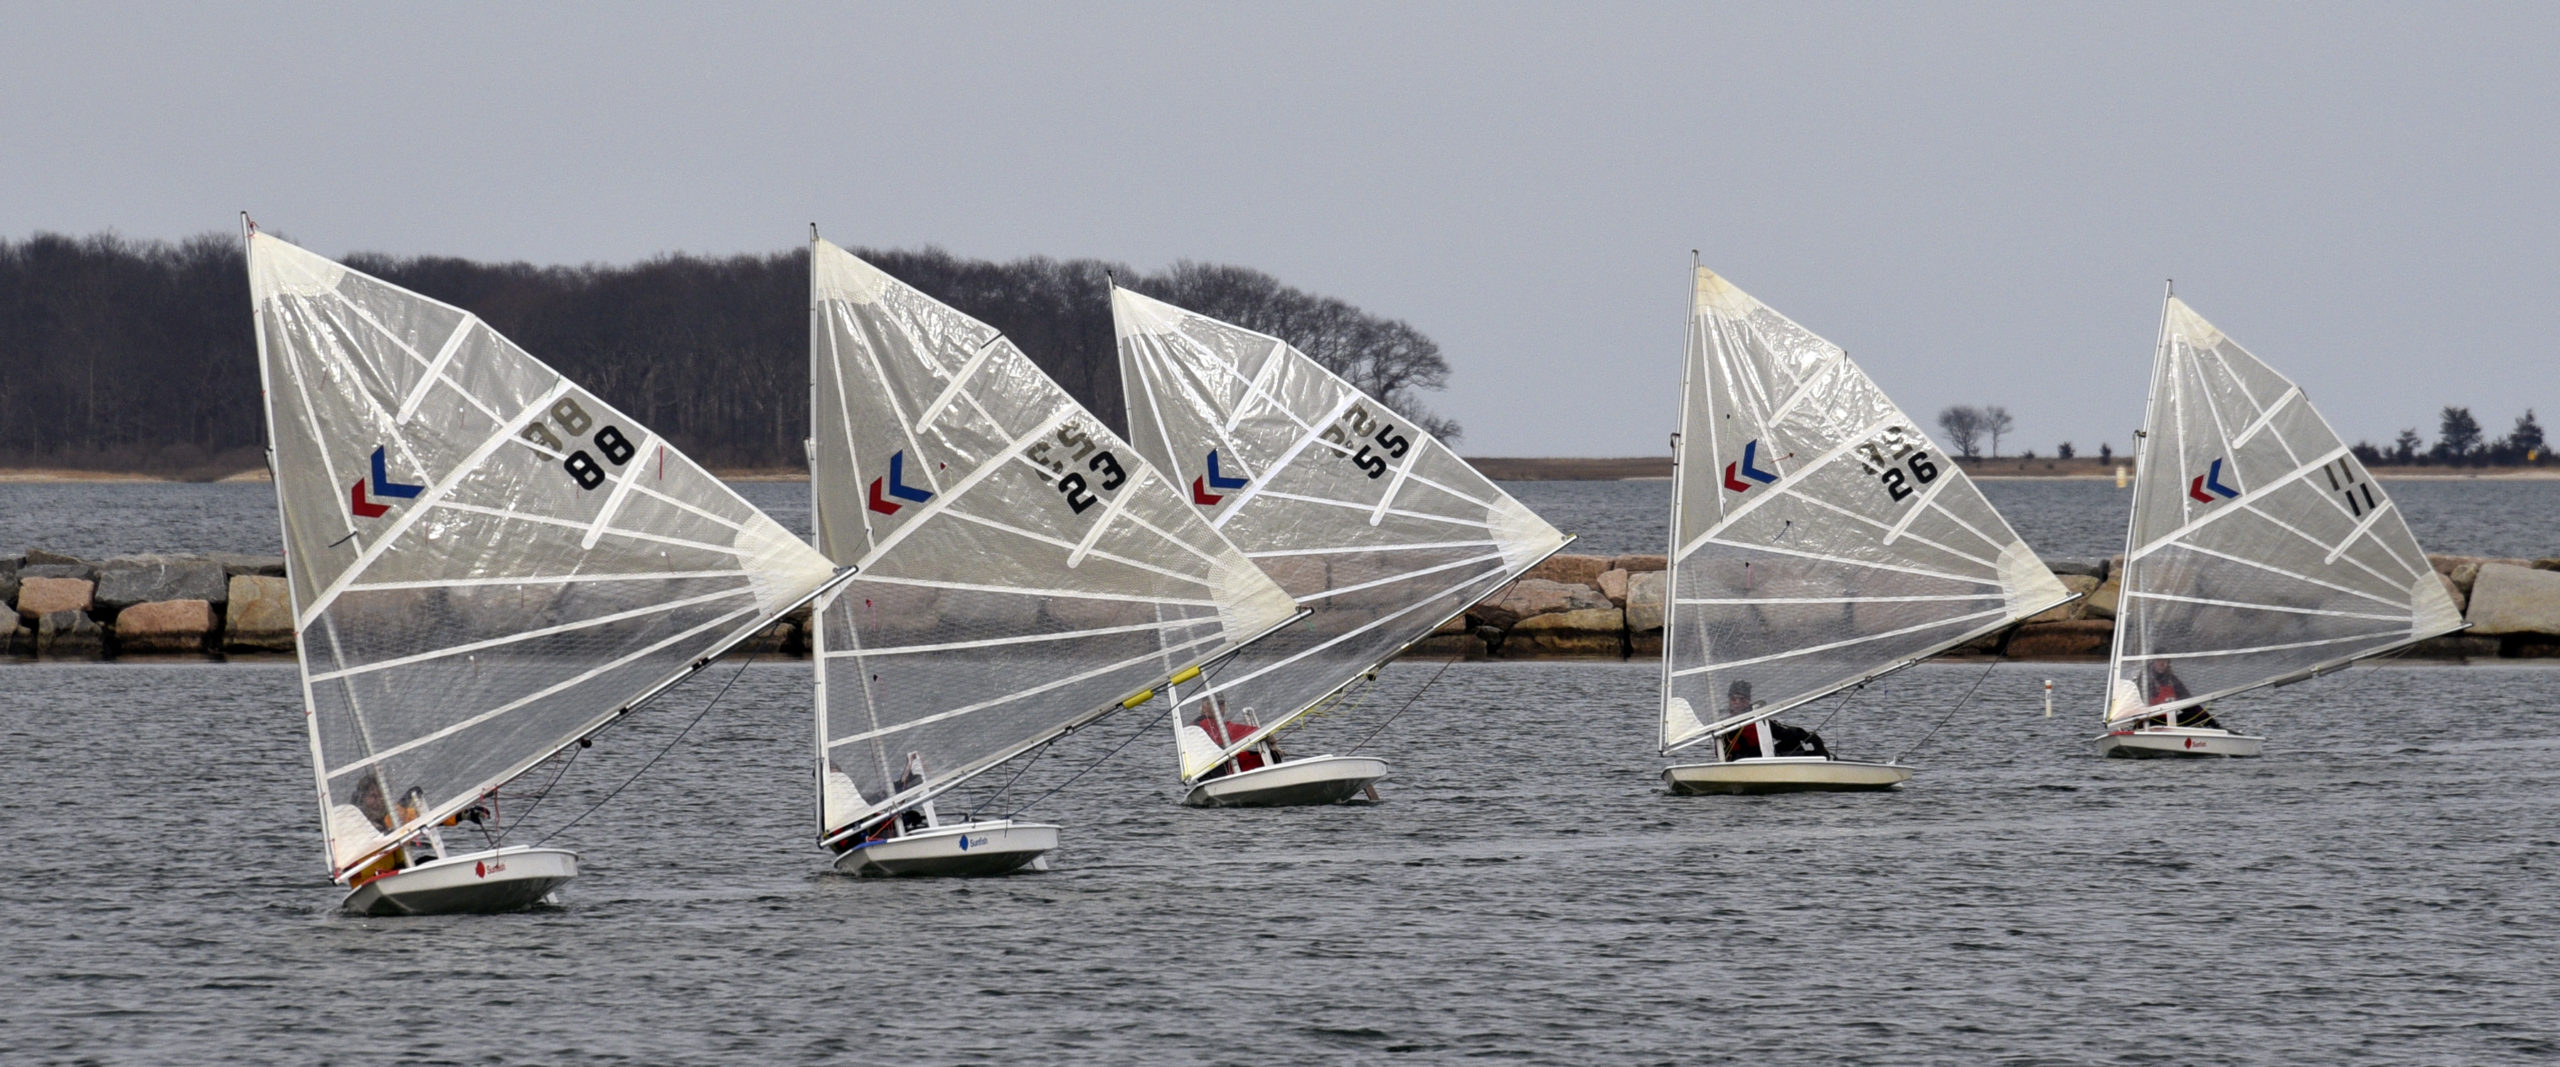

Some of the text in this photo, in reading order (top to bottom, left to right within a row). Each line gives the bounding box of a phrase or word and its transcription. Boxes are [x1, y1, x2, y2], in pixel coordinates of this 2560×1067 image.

[564, 425, 635, 490] 88
[1352, 424, 1409, 479] 55
[1882, 451, 1938, 502] 26
[1058, 451, 1126, 515] 23
[2345, 482, 2376, 516] 11
